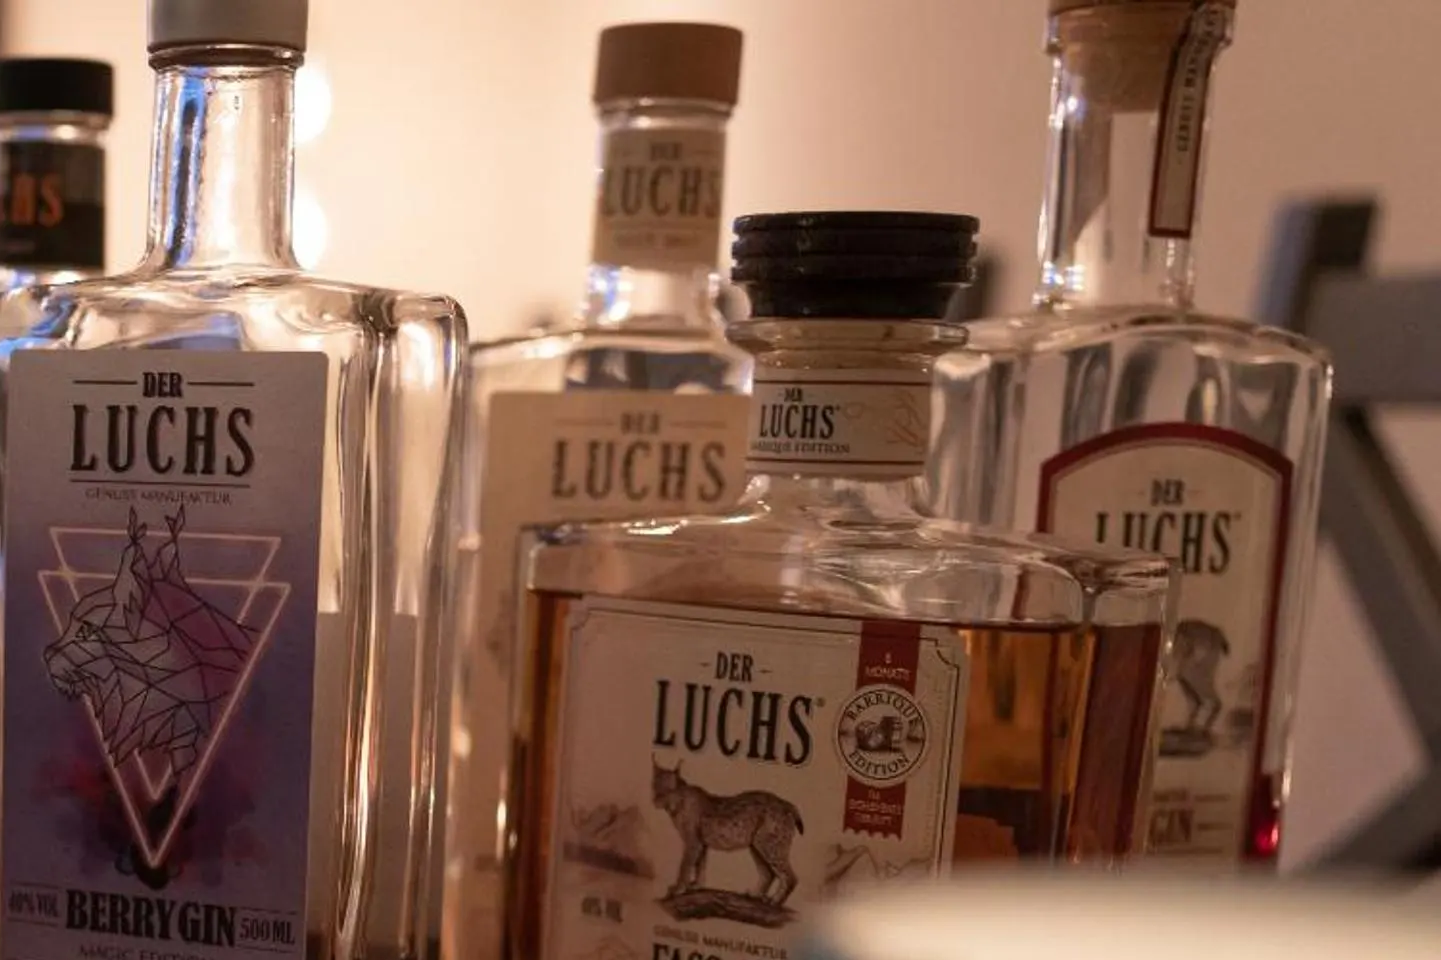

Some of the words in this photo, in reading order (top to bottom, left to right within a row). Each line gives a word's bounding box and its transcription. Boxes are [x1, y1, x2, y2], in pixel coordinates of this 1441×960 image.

[142, 372, 183, 398] DER
[620, 411, 659, 435] DER
[759, 404, 835, 440] LUCHS
[70, 404, 255, 477] LUCHS
[551, 439, 727, 502] LUCHS
[1151, 479, 1186, 506] DER
[714, 651, 755, 683] DER
[652, 679, 813, 766] LUCHS
[847, 692, 922, 730] BARRIQUE
[848, 750, 909, 776] EDITION
[178, 900, 239, 948] GIN
